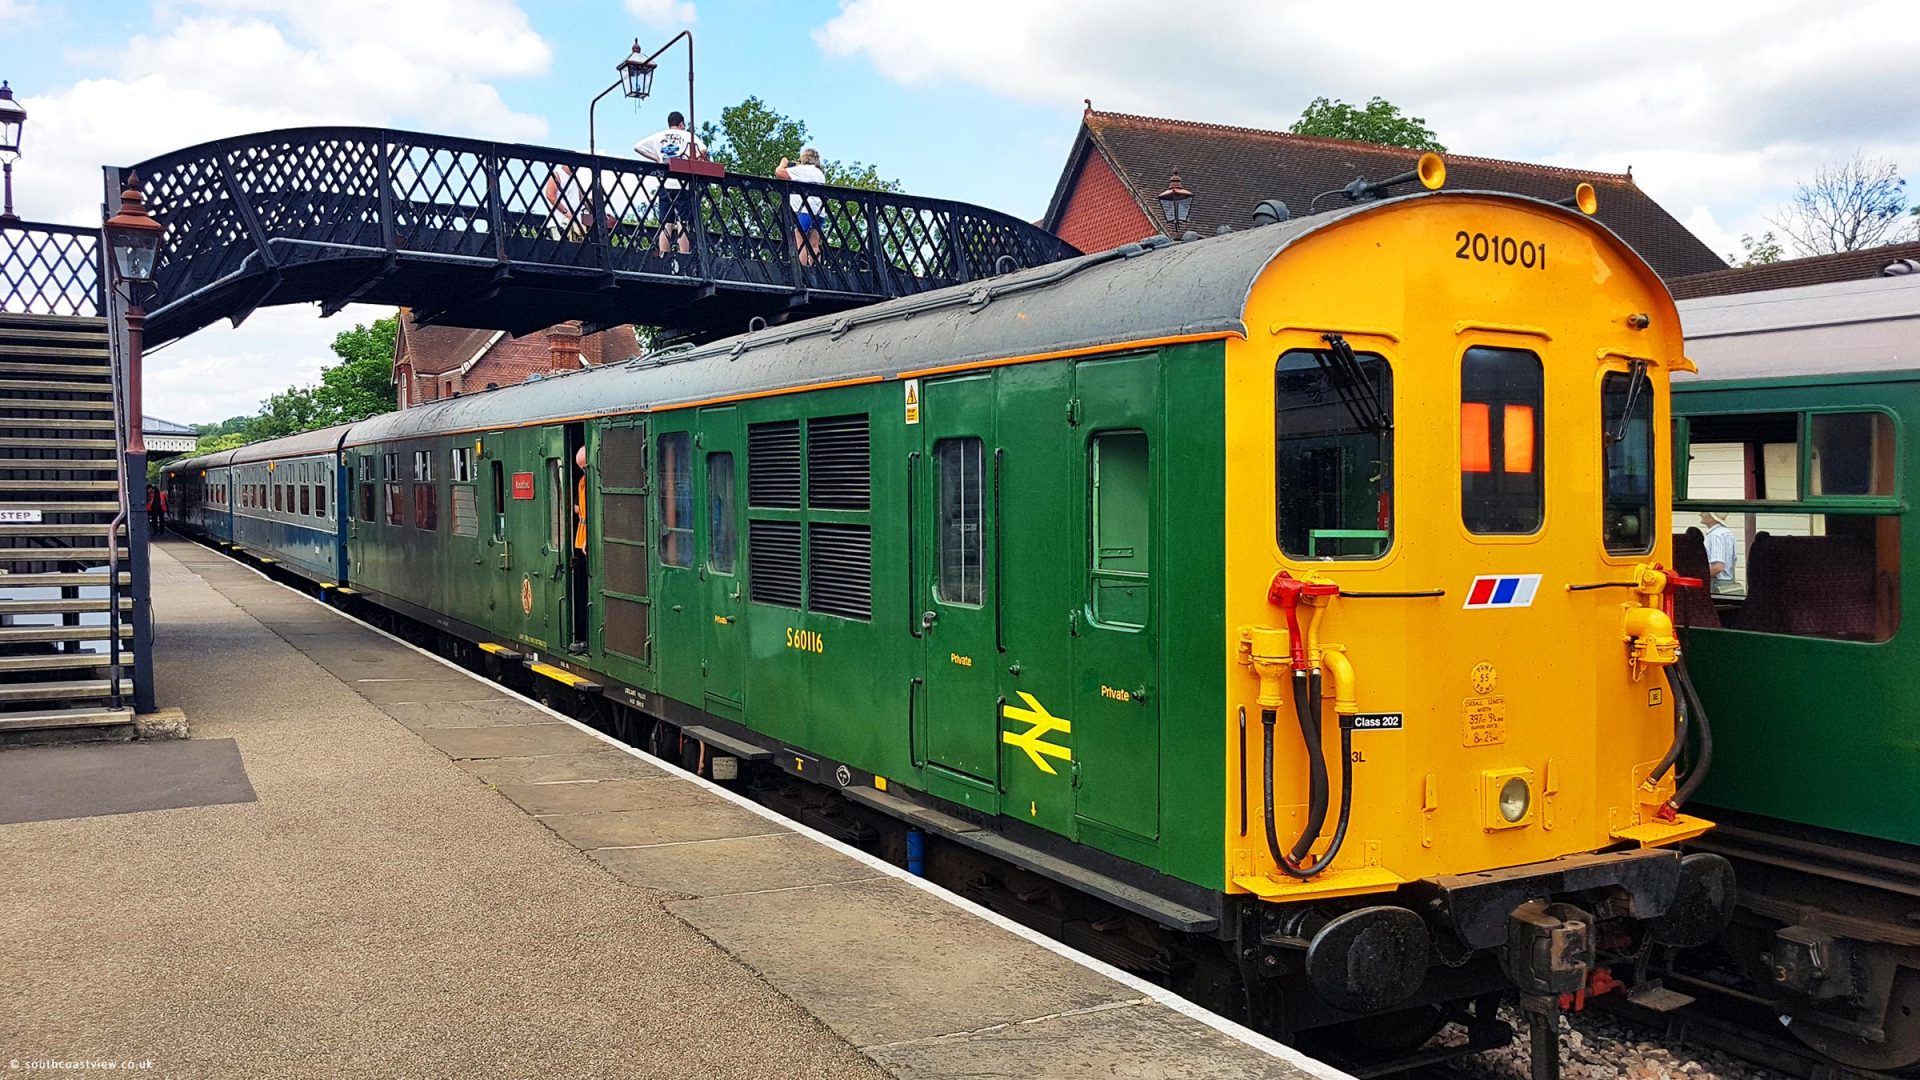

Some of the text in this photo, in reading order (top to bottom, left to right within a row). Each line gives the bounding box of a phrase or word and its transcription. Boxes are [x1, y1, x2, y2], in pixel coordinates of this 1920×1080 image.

[1455, 230, 1545, 270] 201001
[0, 511, 31, 520] STEP
[950, 652, 972, 667] Private
[1101, 684, 1130, 702] Private
[1354, 716, 1399, 727] Class 202
[1351, 751, 1366, 763] 3L
